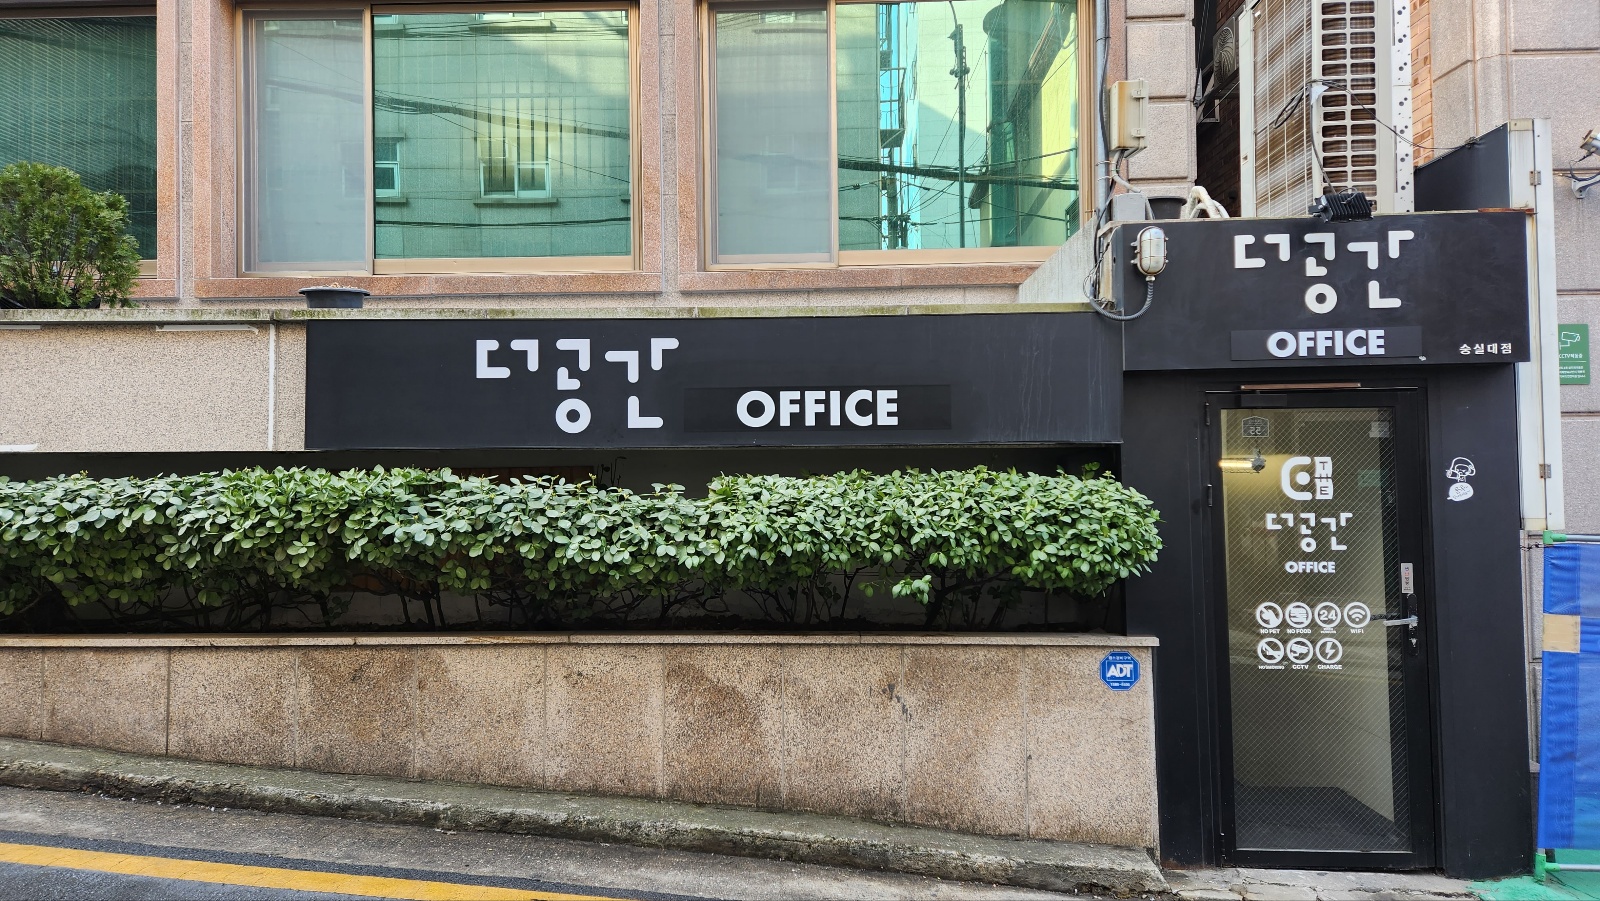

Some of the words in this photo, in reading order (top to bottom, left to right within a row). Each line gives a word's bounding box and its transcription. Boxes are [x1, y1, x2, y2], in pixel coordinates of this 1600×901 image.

[1234, 230, 1414, 313] 더공간
[1267, 330, 1385, 357] OFFICE
[1459, 343, 1512, 354] 숭실대점
[476, 337, 679, 433] 더공간
[737, 390, 898, 427] OFFICE
[1266, 512, 1353, 552] 더공간
[1284, 561, 1336, 573] OFFICE
[1319, 609, 1337, 621] 24
[1106, 664, 1133, 677] ADT
